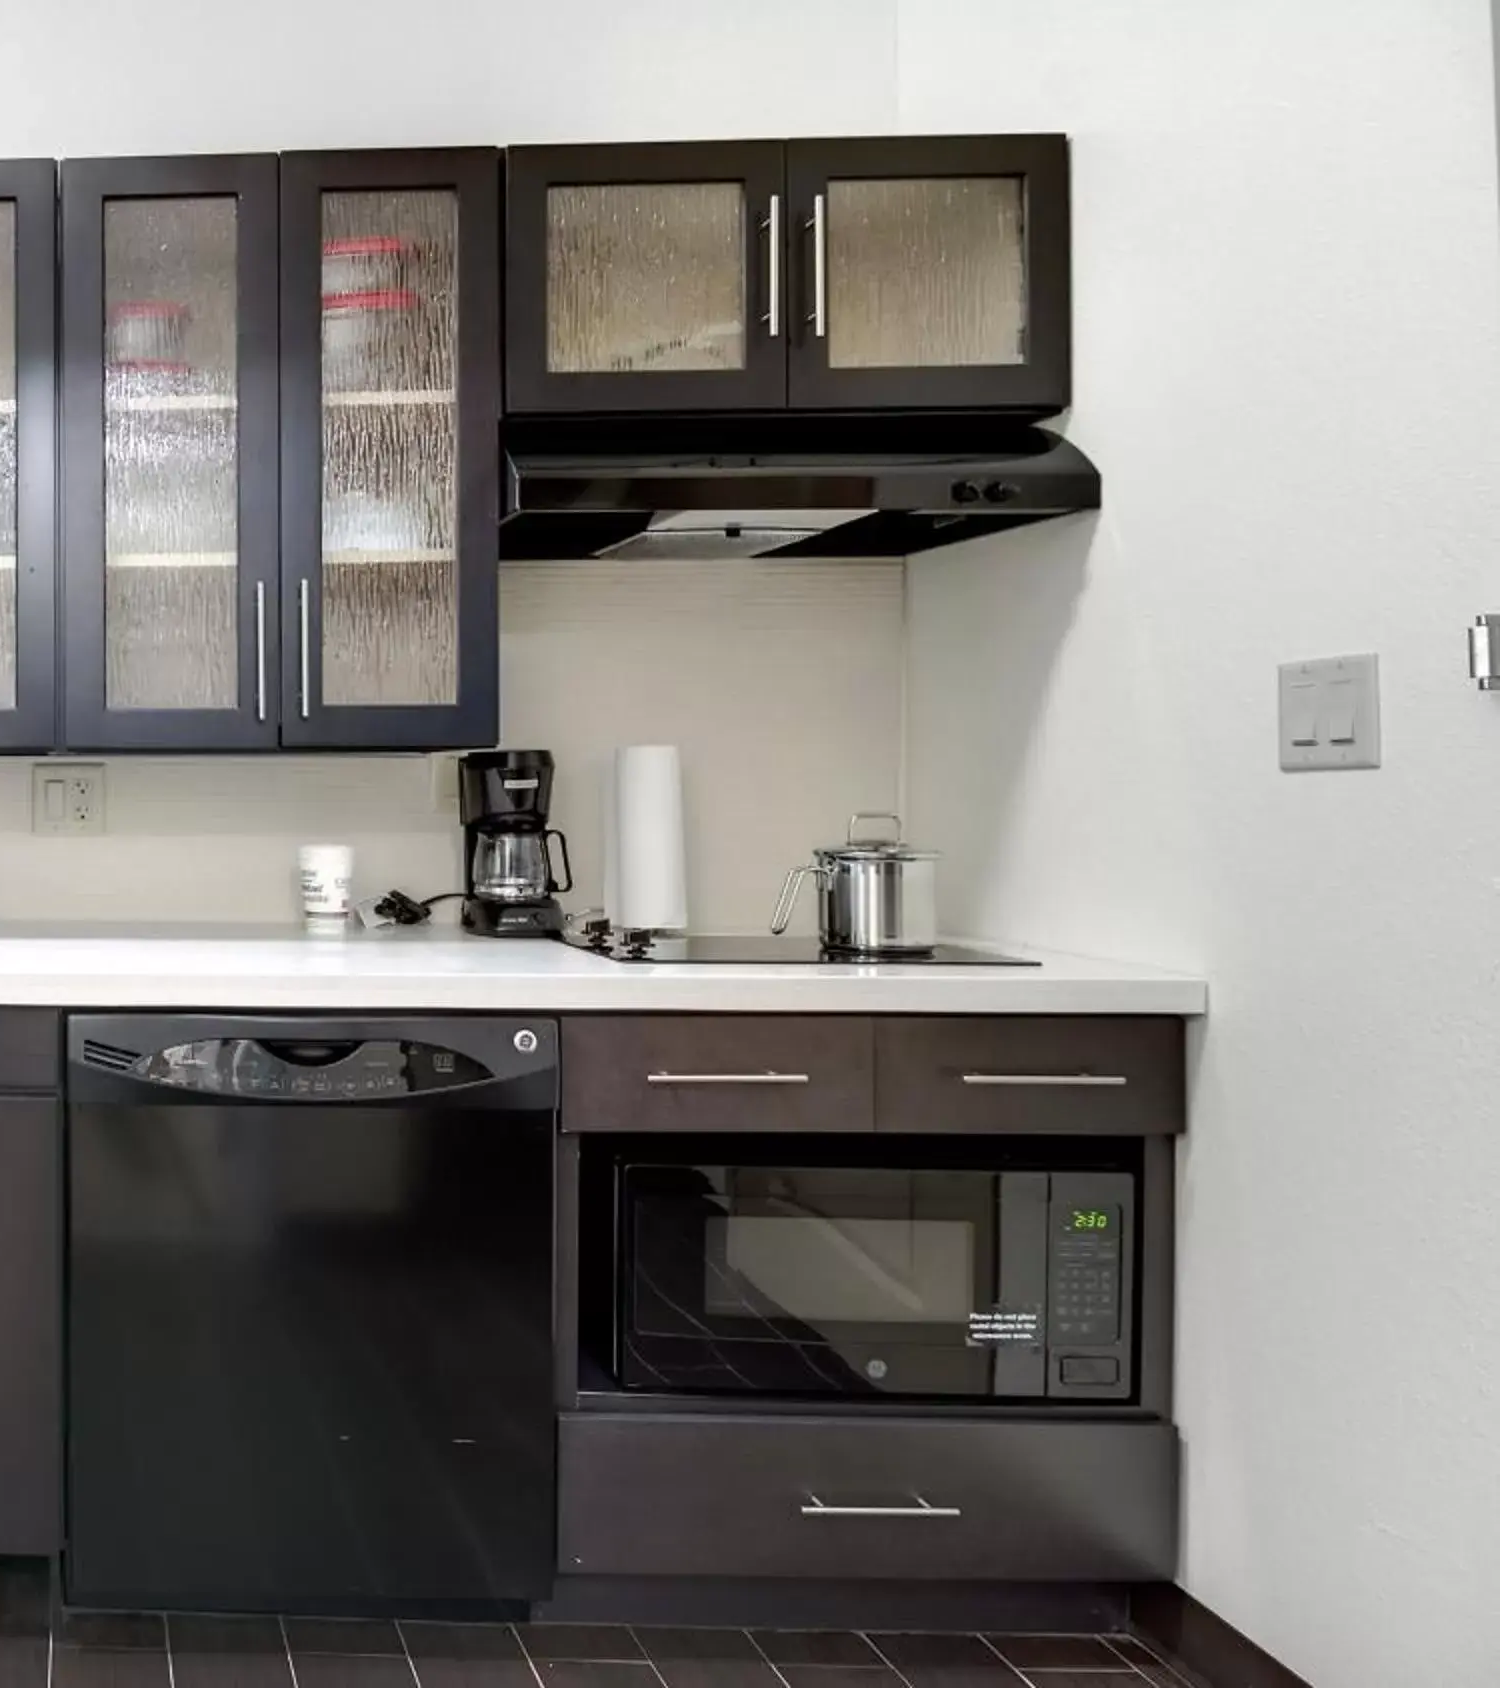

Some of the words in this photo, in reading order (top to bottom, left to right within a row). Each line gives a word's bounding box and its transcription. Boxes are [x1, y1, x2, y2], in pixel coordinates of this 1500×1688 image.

[1075, 1215, 1107, 1229] 2:30
[969, 1312, 993, 1321] Please
[993, 1312, 1002, 1321] do
[1003, 1313, 1017, 1321] not
[1017, 1313, 1037, 1322] place
